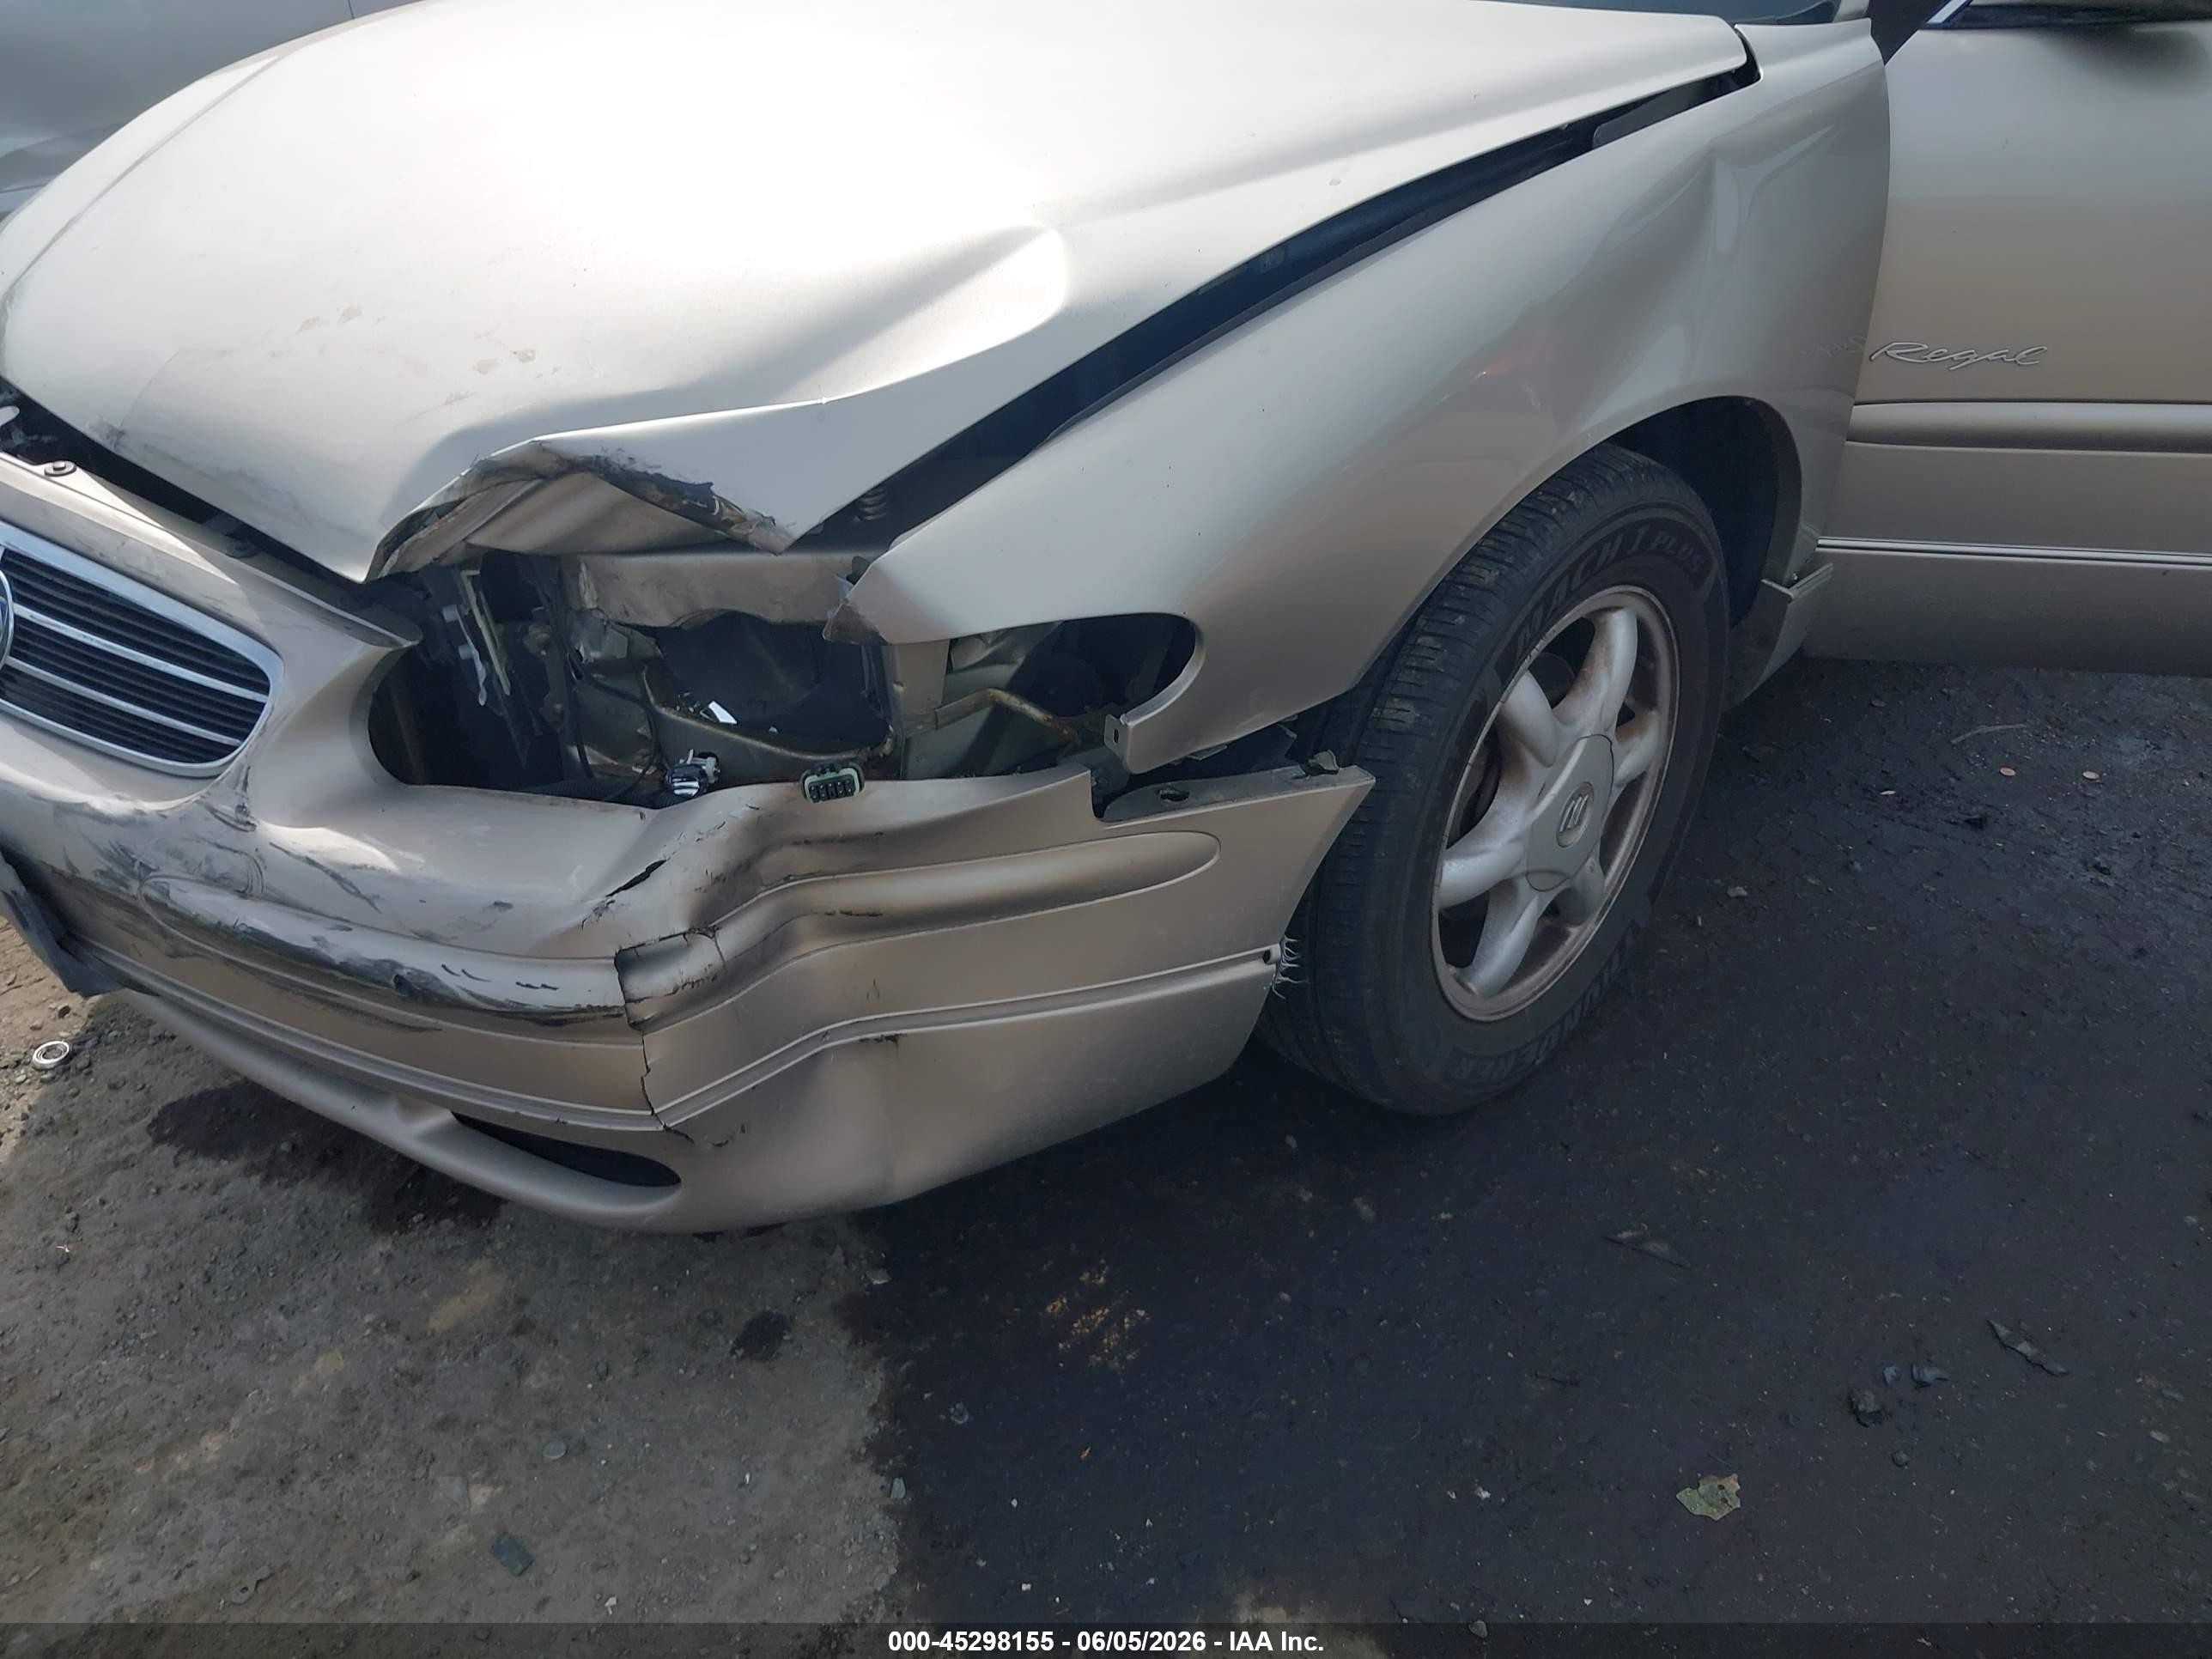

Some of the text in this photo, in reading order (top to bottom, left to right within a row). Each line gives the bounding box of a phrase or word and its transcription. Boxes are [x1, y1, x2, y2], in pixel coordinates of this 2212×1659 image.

[1869, 341, 2048, 370] Regal
[1517, 532, 1624, 662] MACH
[1648, 531, 1704, 574] PLUS
